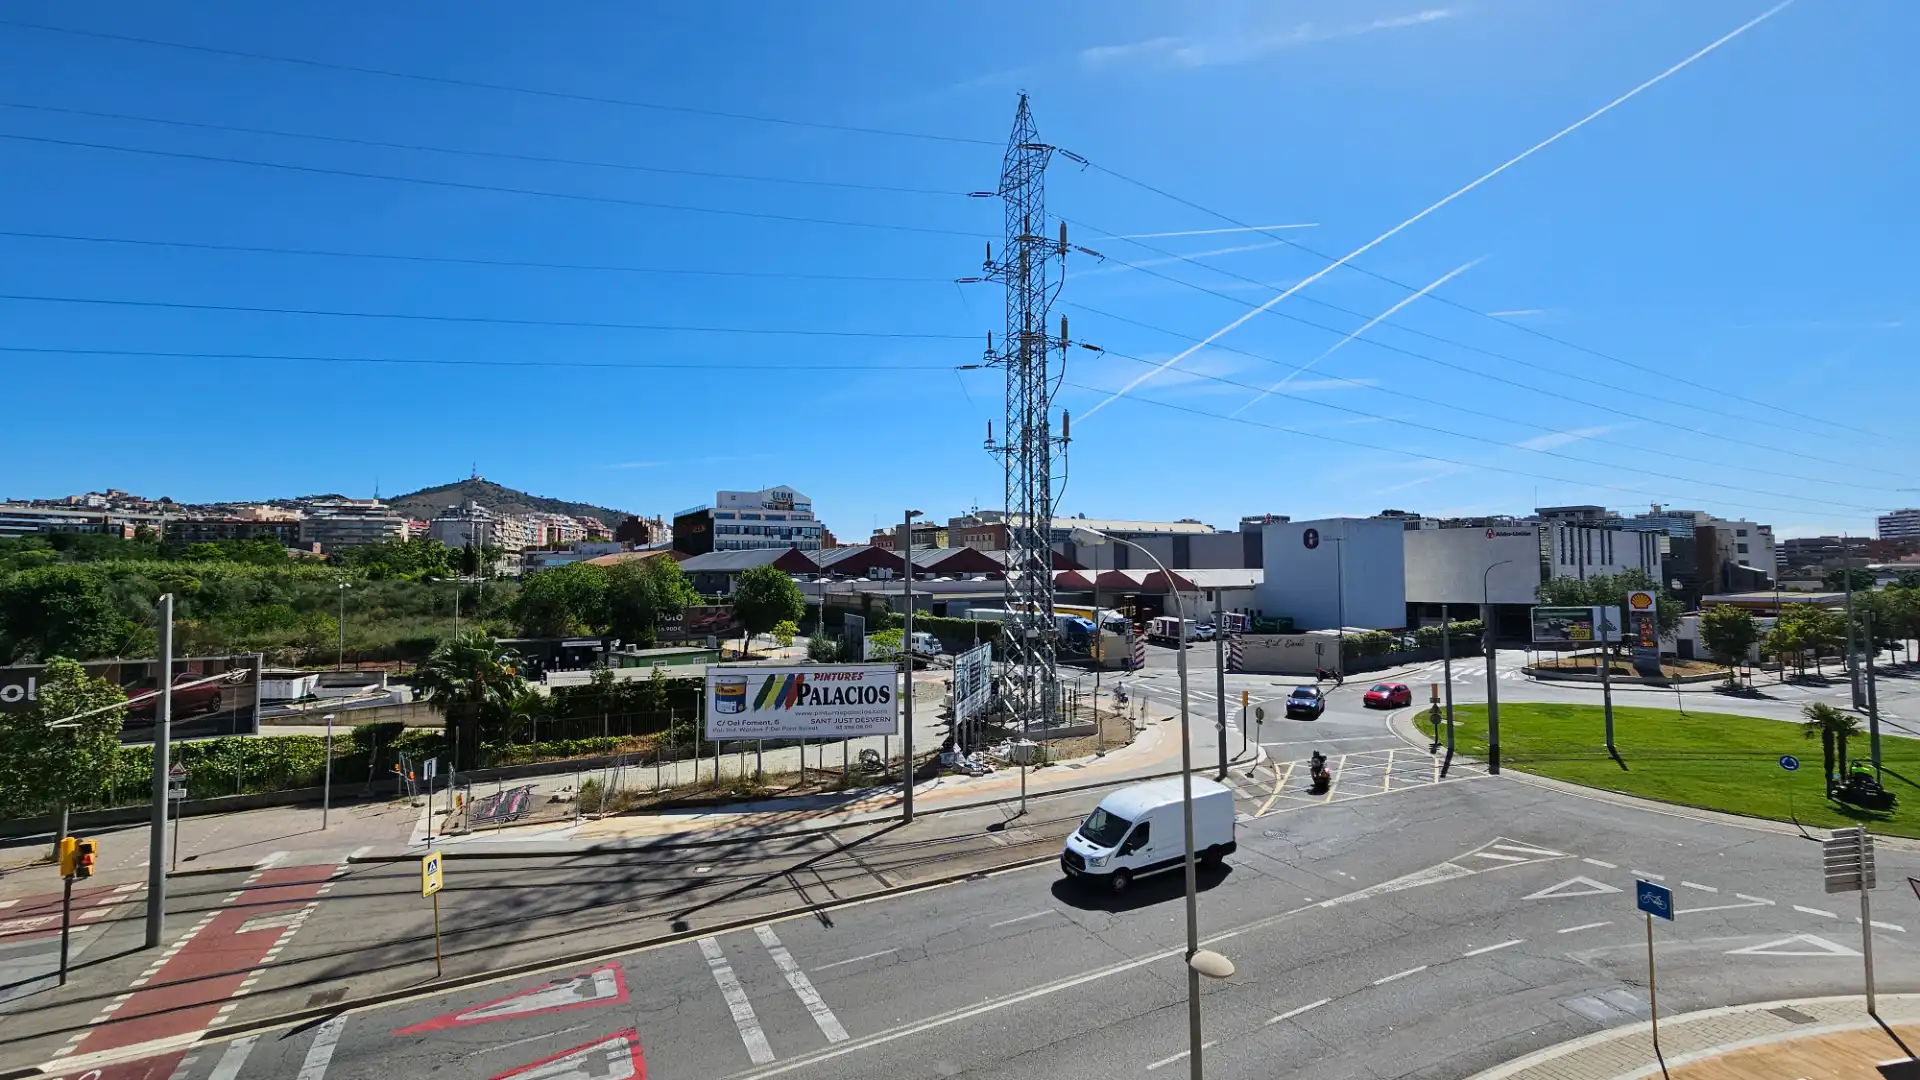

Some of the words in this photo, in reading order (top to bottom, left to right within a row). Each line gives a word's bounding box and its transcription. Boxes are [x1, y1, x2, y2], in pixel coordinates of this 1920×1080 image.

[813, 671, 864, 681] PINTURES
[796, 683, 891, 706] PALACIOS
[855, 716, 891, 724] DESVERN
